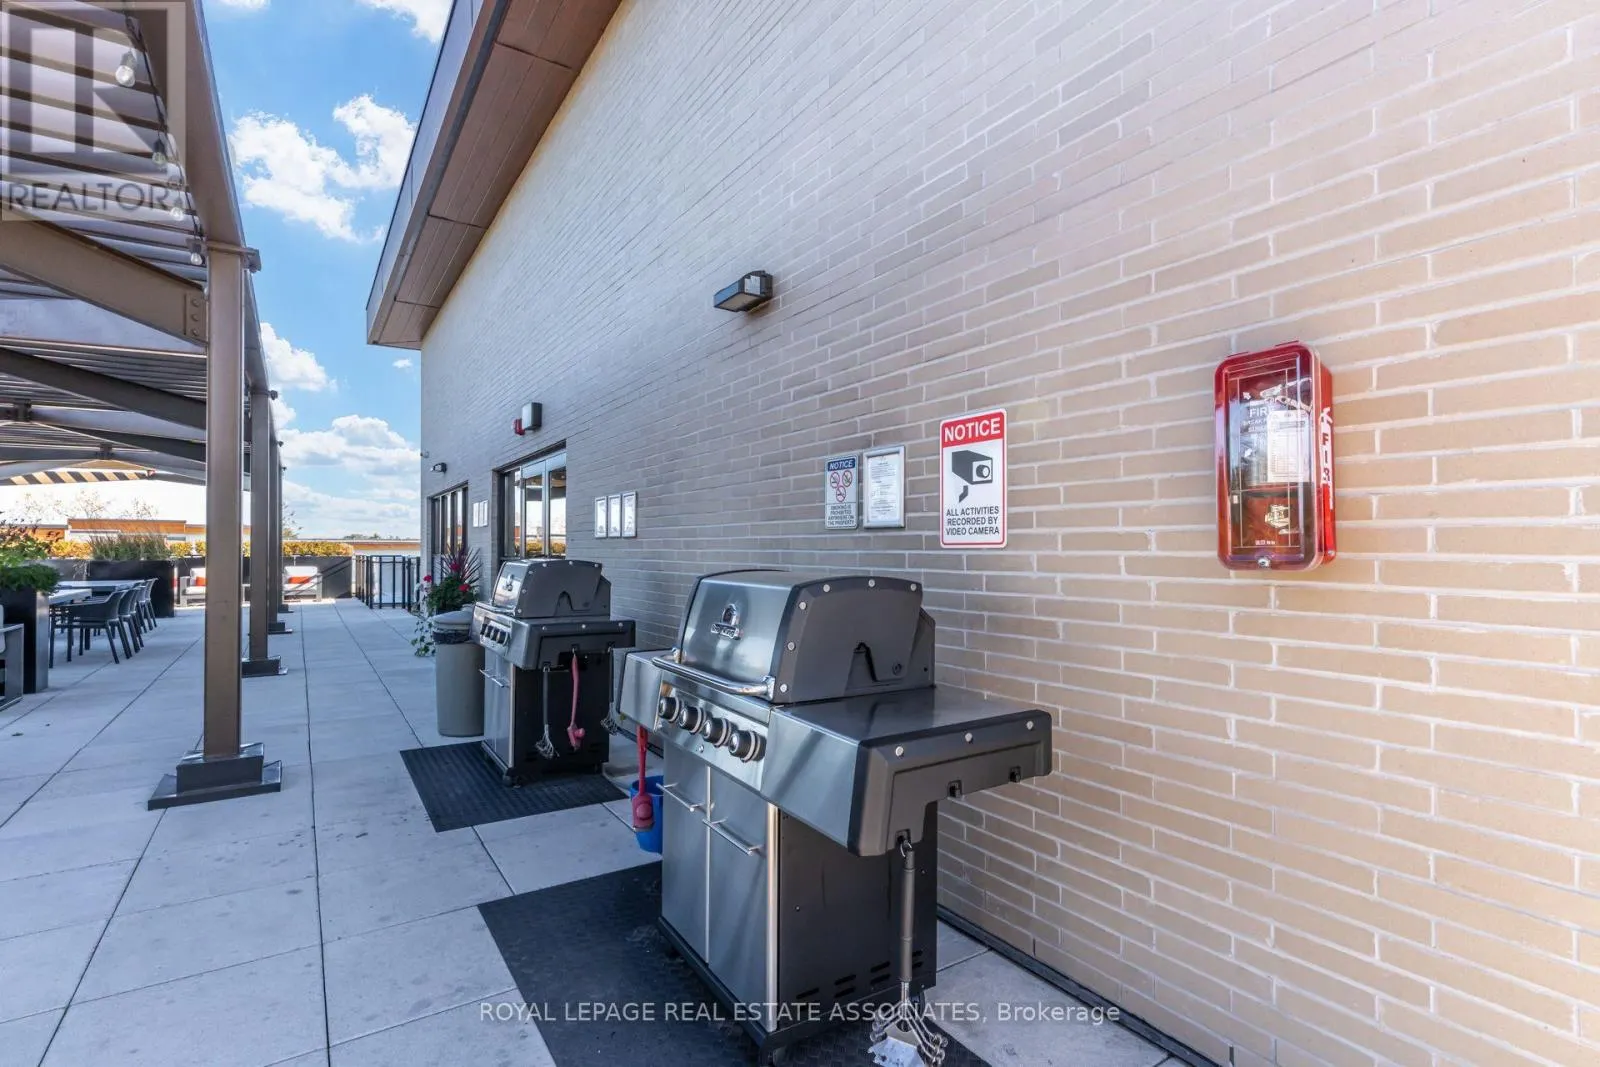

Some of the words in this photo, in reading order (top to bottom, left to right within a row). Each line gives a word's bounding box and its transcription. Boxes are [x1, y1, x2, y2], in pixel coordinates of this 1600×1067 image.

[944, 417, 1001, 443] NOTICE
[829, 459, 854, 470] NOTICE
[960, 506, 999, 516] ACTIVITIES
[947, 517, 986, 526] RECORDED
[988, 516, 998, 524] BY
[968, 527, 1000, 535] CAMERA
